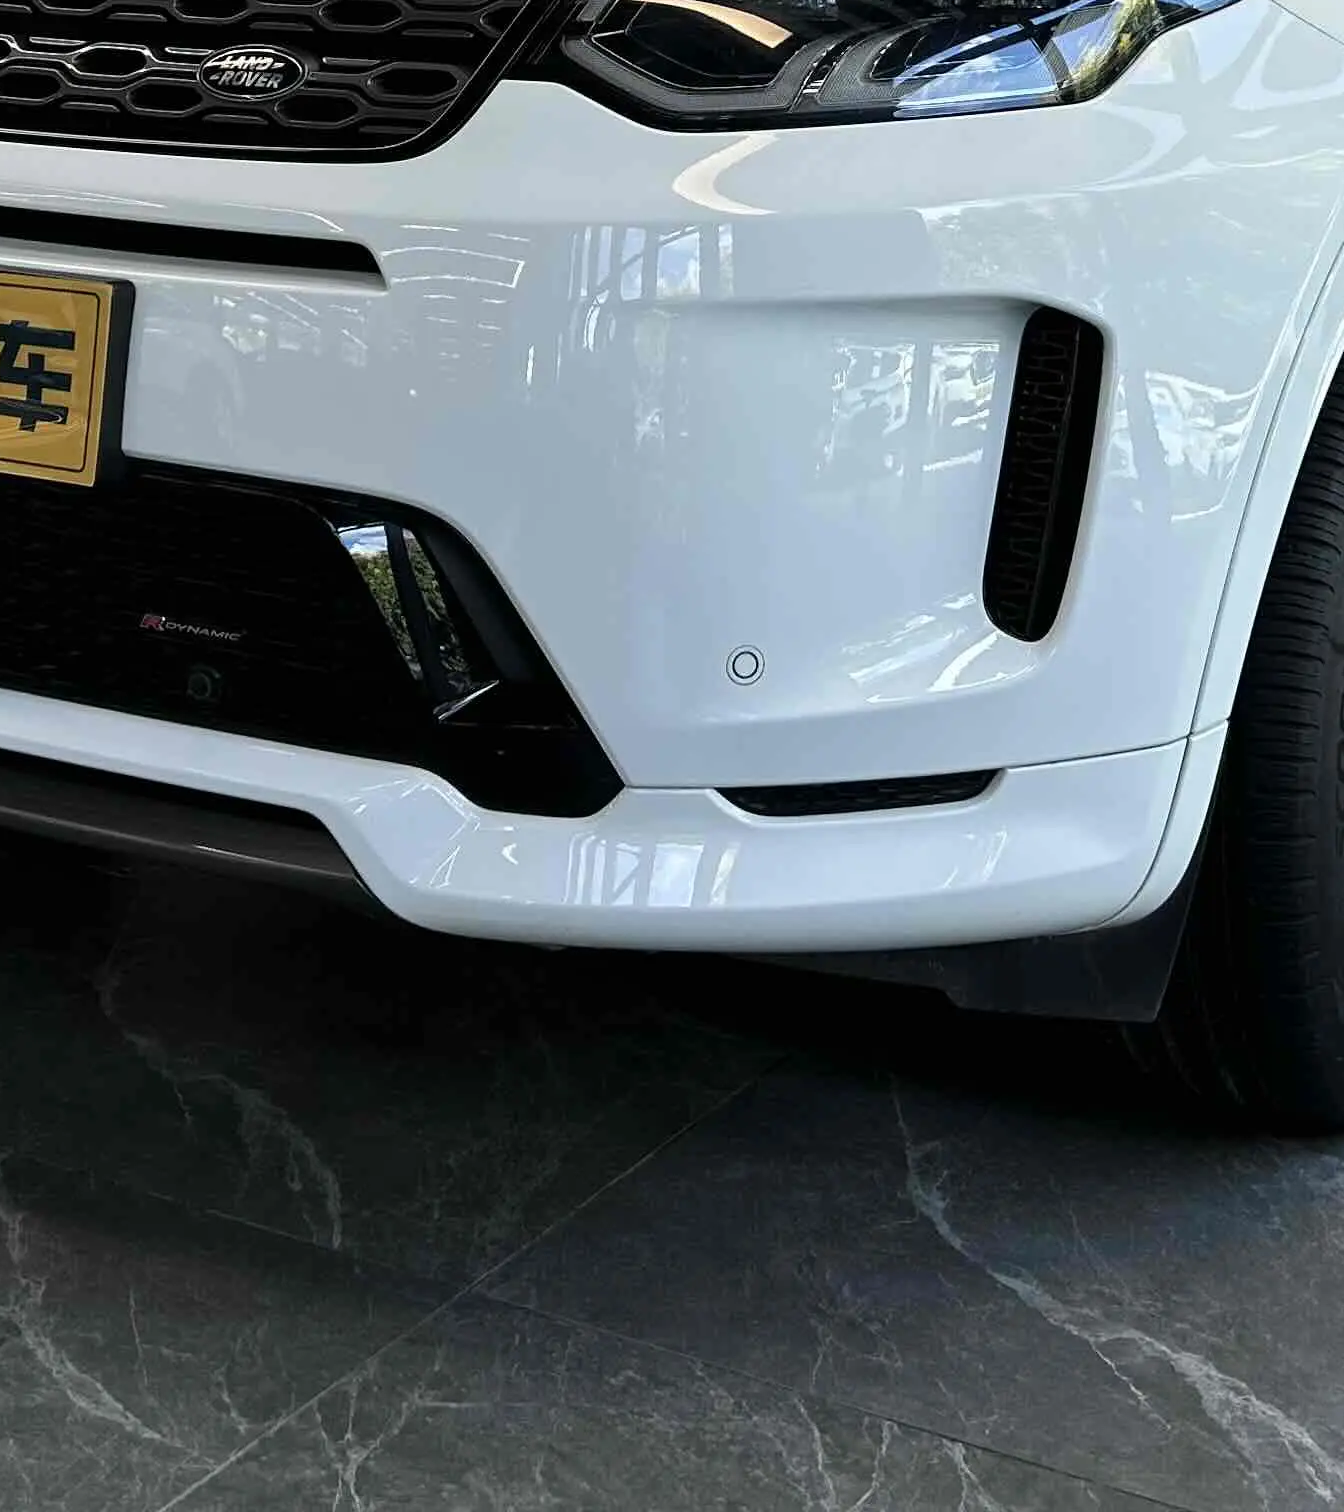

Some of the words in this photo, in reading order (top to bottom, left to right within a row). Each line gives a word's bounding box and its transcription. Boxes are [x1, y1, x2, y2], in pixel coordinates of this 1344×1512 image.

[221, 56, 274, 70] LAND
[218, 70, 283, 88] ROVER
[166, 621, 242, 640] DYNAMIC
